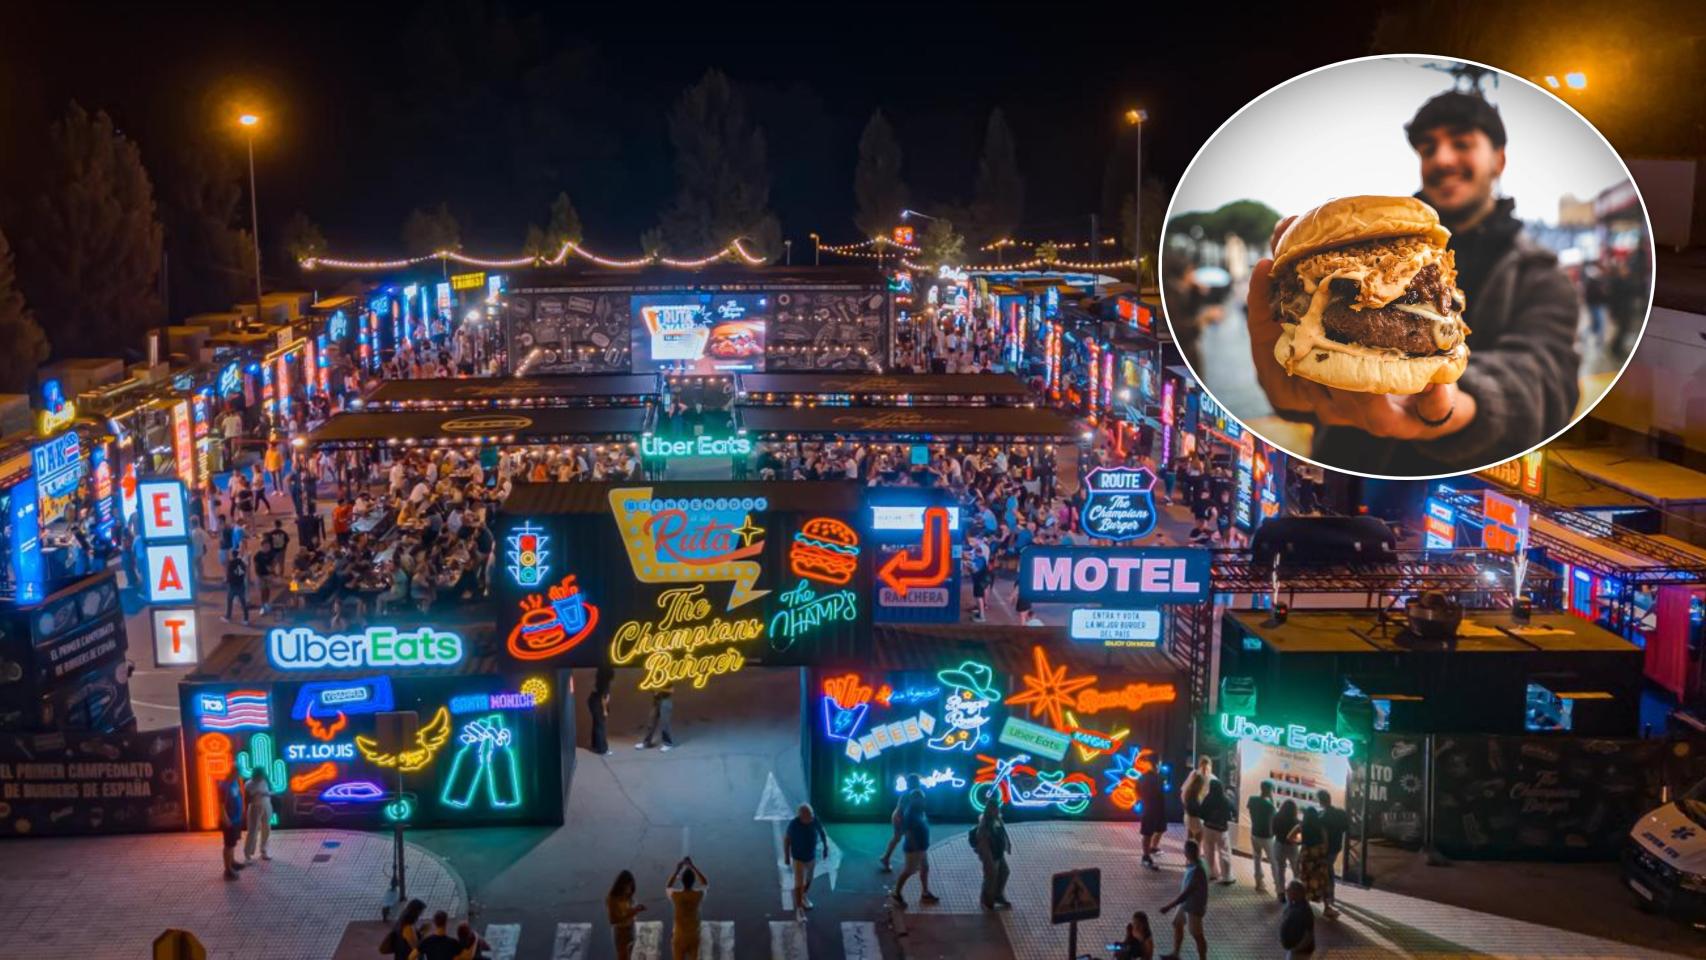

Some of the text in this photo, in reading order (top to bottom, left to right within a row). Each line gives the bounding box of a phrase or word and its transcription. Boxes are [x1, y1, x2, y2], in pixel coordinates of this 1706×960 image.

[642, 436, 751, 457] Uber Eats
[1101, 473, 1140, 488] ROUTE
[1089, 504, 1149, 521] Champions
[1109, 495, 1130, 510] The
[643, 509, 764, 566] Ruta
[1098, 518, 1139, 534] Burger
[1033, 557, 1200, 593] MOTEL
[657, 584, 712, 630] The
[780, 579, 815, 607] The
[277, 630, 458, 663] Uber Eats
[611, 618, 764, 664] Champions
[639, 647, 745, 690] Burger
[1009, 726, 1061, 750] Uber Eats
[1221, 713, 1284, 745] Uber
[1288, 724, 1354, 757] Eats
